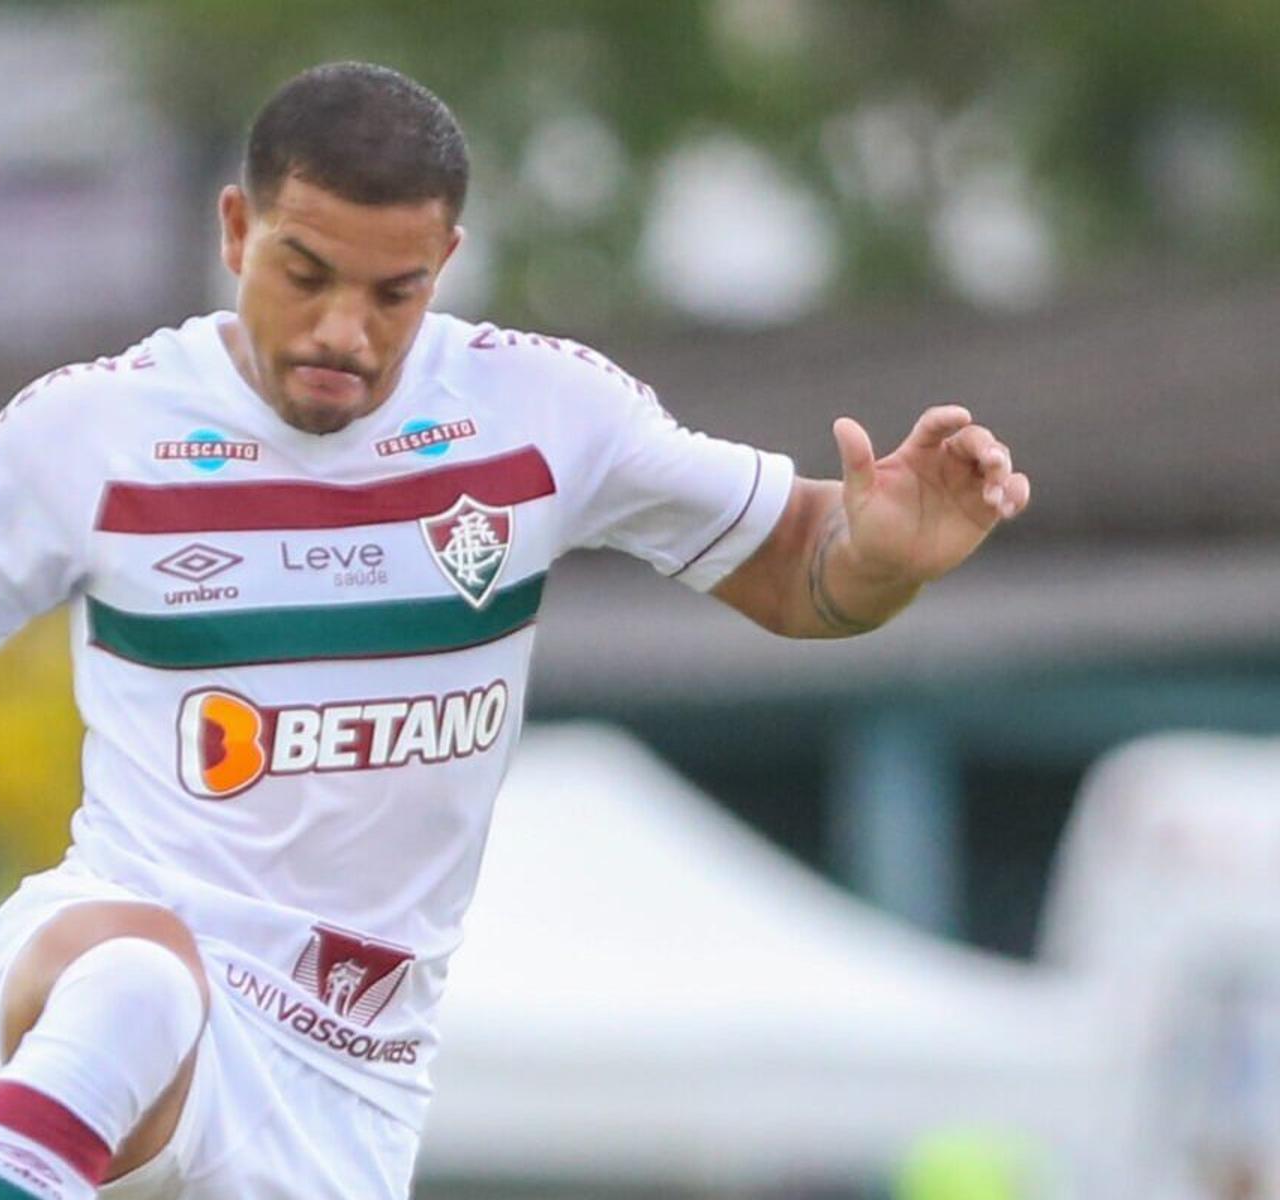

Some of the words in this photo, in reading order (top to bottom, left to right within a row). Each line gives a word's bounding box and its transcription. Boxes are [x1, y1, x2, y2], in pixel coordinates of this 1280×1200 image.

[155, 441, 257, 461] FRESCATTO
[378, 419, 476, 456] FRESCATTO
[280, 541, 384, 570] Leve
[163, 584, 239, 606] umbro
[270, 680, 508, 776] BETANO
